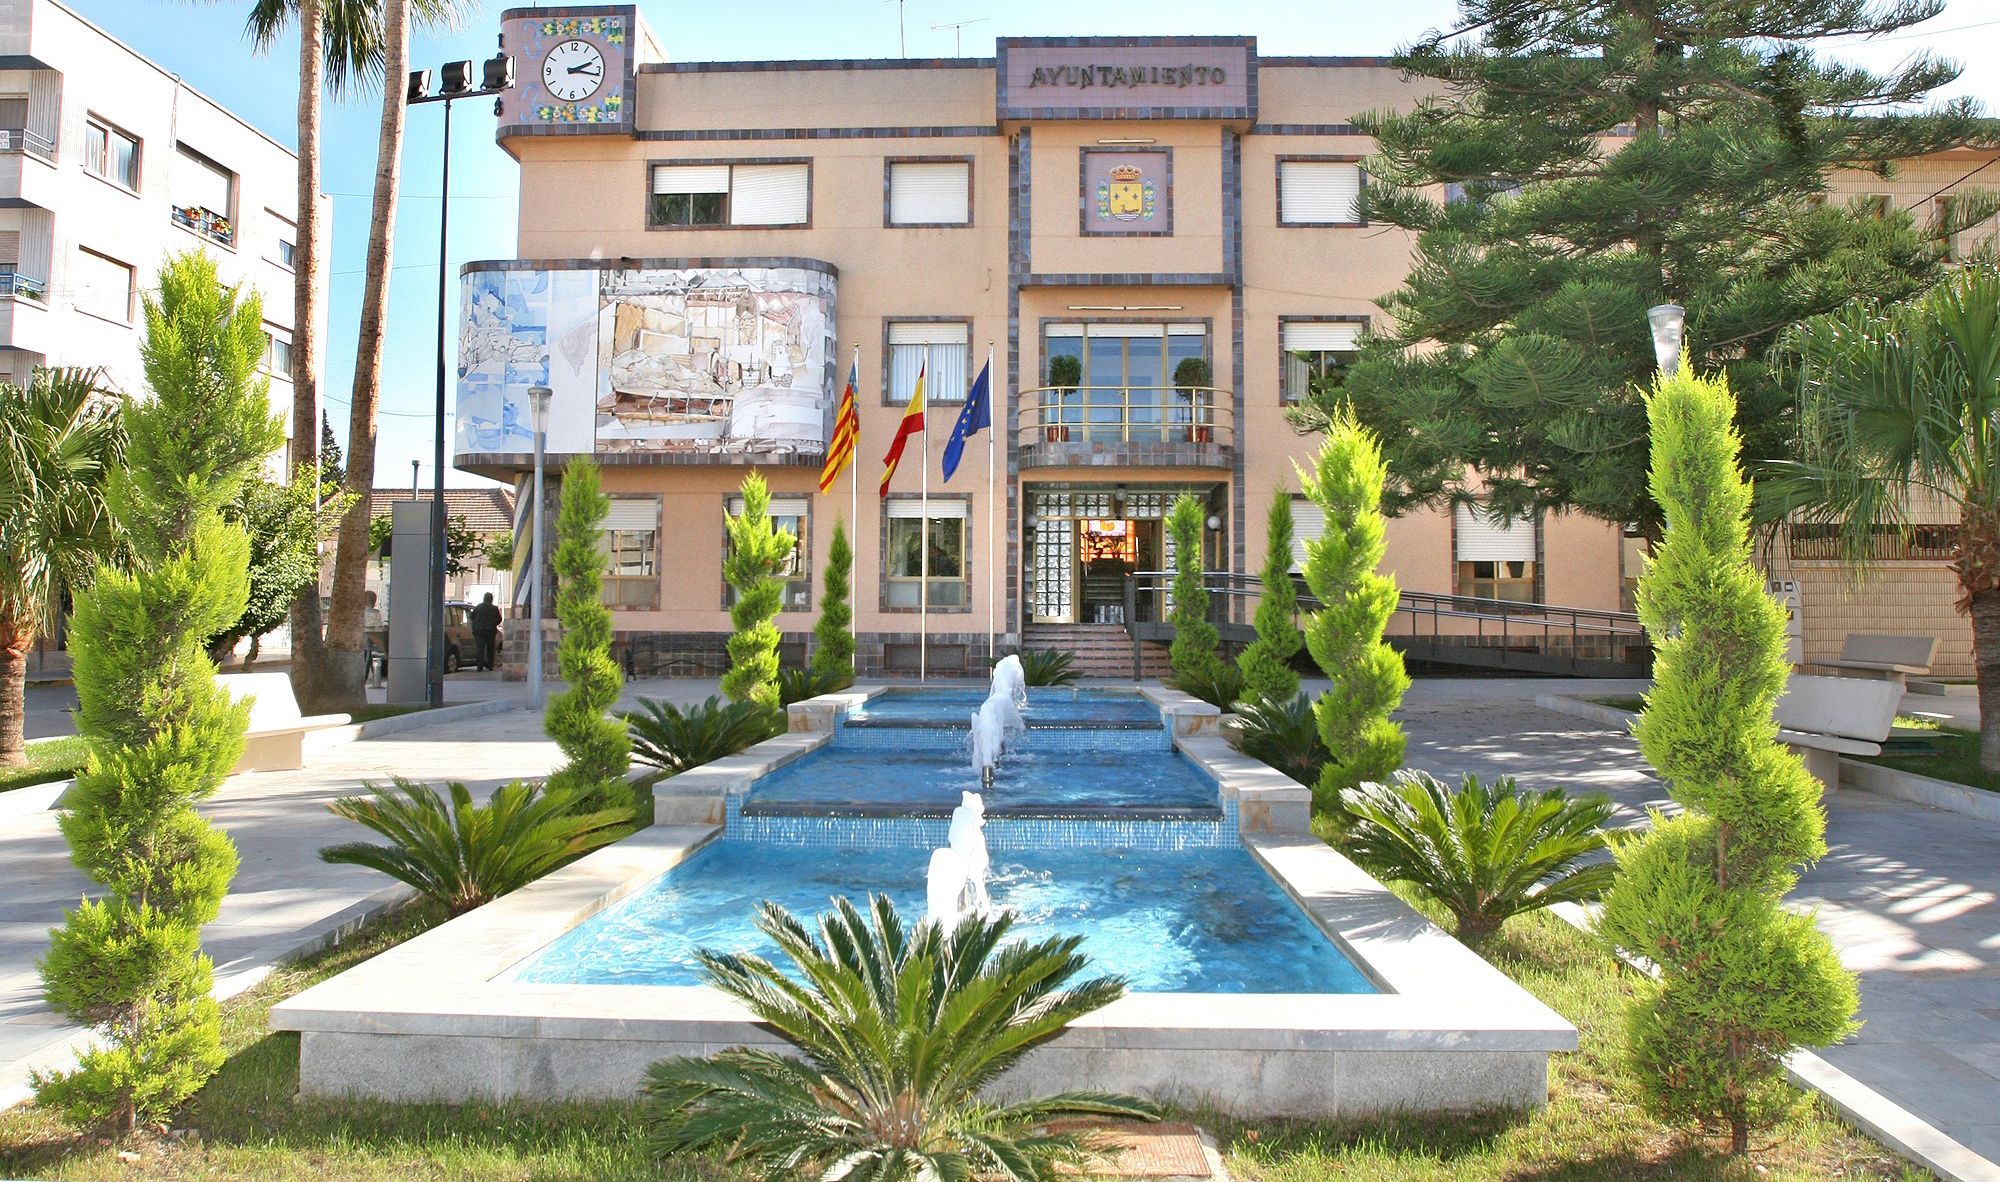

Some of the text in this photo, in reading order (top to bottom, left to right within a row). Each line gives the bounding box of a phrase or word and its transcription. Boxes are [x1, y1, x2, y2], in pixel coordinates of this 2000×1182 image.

[571, 42, 579, 51] 12
[546, 67, 552, 75] 9
[596, 66, 602, 75] 3
[1029, 64, 1226, 89] AYUNTAMIENTO
[570, 91, 575, 99] 6
